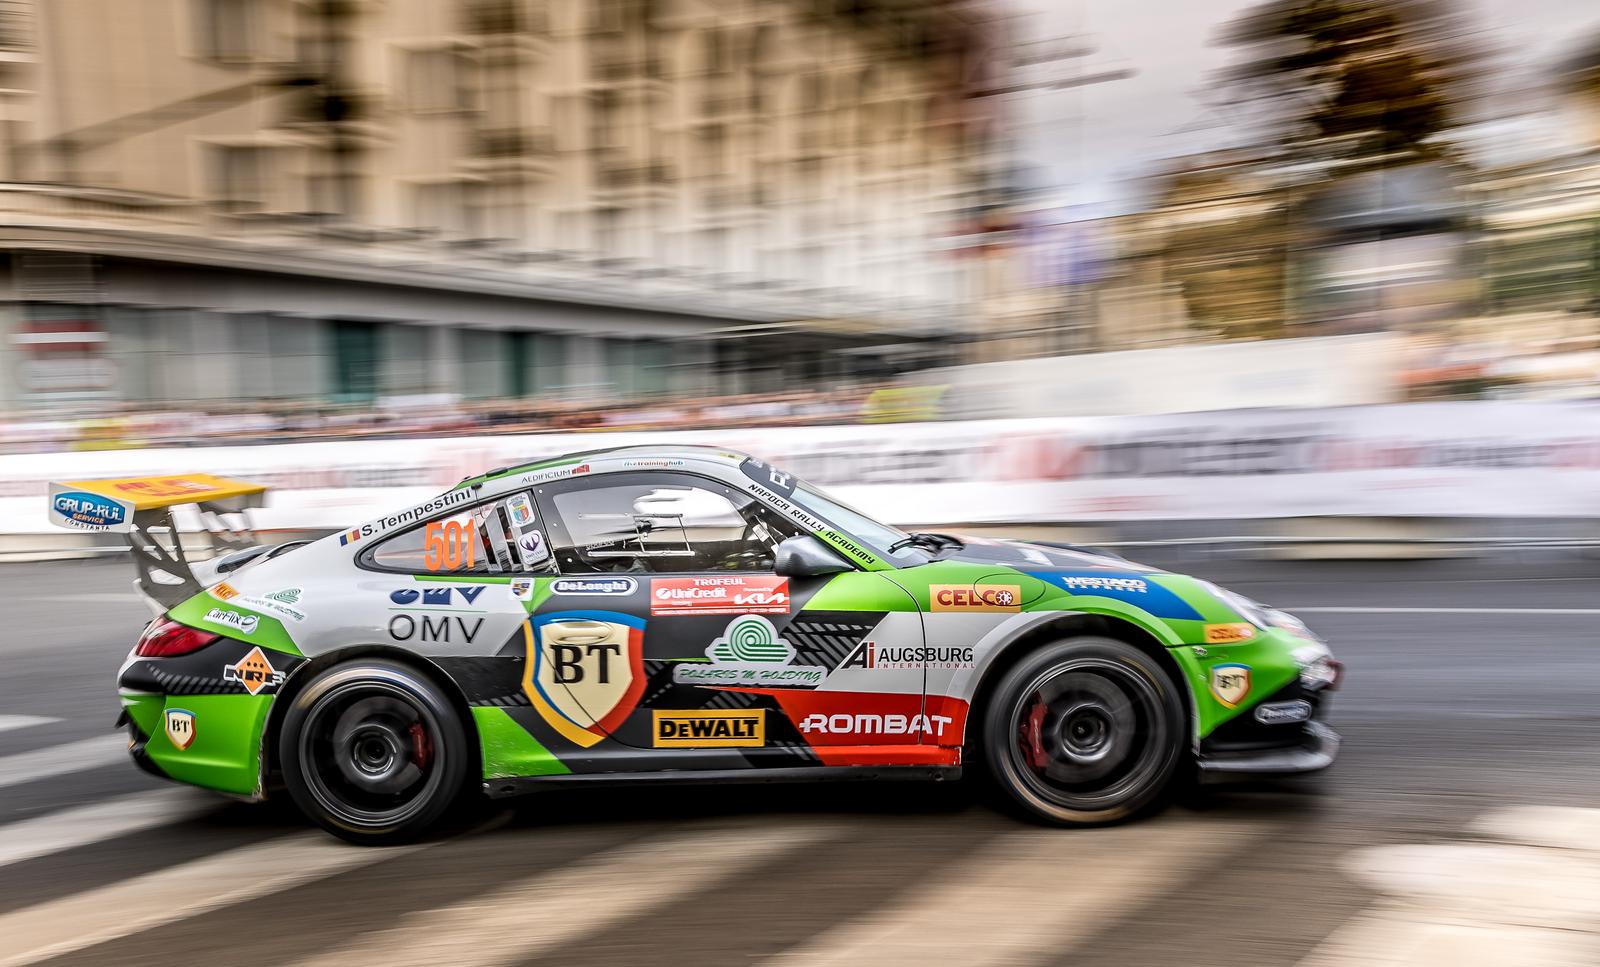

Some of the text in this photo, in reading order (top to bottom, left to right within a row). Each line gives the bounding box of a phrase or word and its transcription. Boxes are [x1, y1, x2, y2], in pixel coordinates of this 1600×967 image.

[521, 469, 571, 484] AEDIFICIUM
[72, 512, 105, 524] SERVICE
[748, 484, 876, 564] NAPOCA RALLY ACADEMY
[424, 519, 475, 572] 501
[693, 578, 746, 586] TROFEUL
[672, 587, 727, 599] UniCredit
[733, 592, 785, 605] KIA
[937, 589, 1014, 606] CELCO
[388, 614, 486, 644] OMV
[878, 647, 973, 662] AUGSBURG
[550, 644, 621, 685] BT
[678, 668, 822, 683] POLARIS M HOLDING
[172, 719, 190, 733] BT
